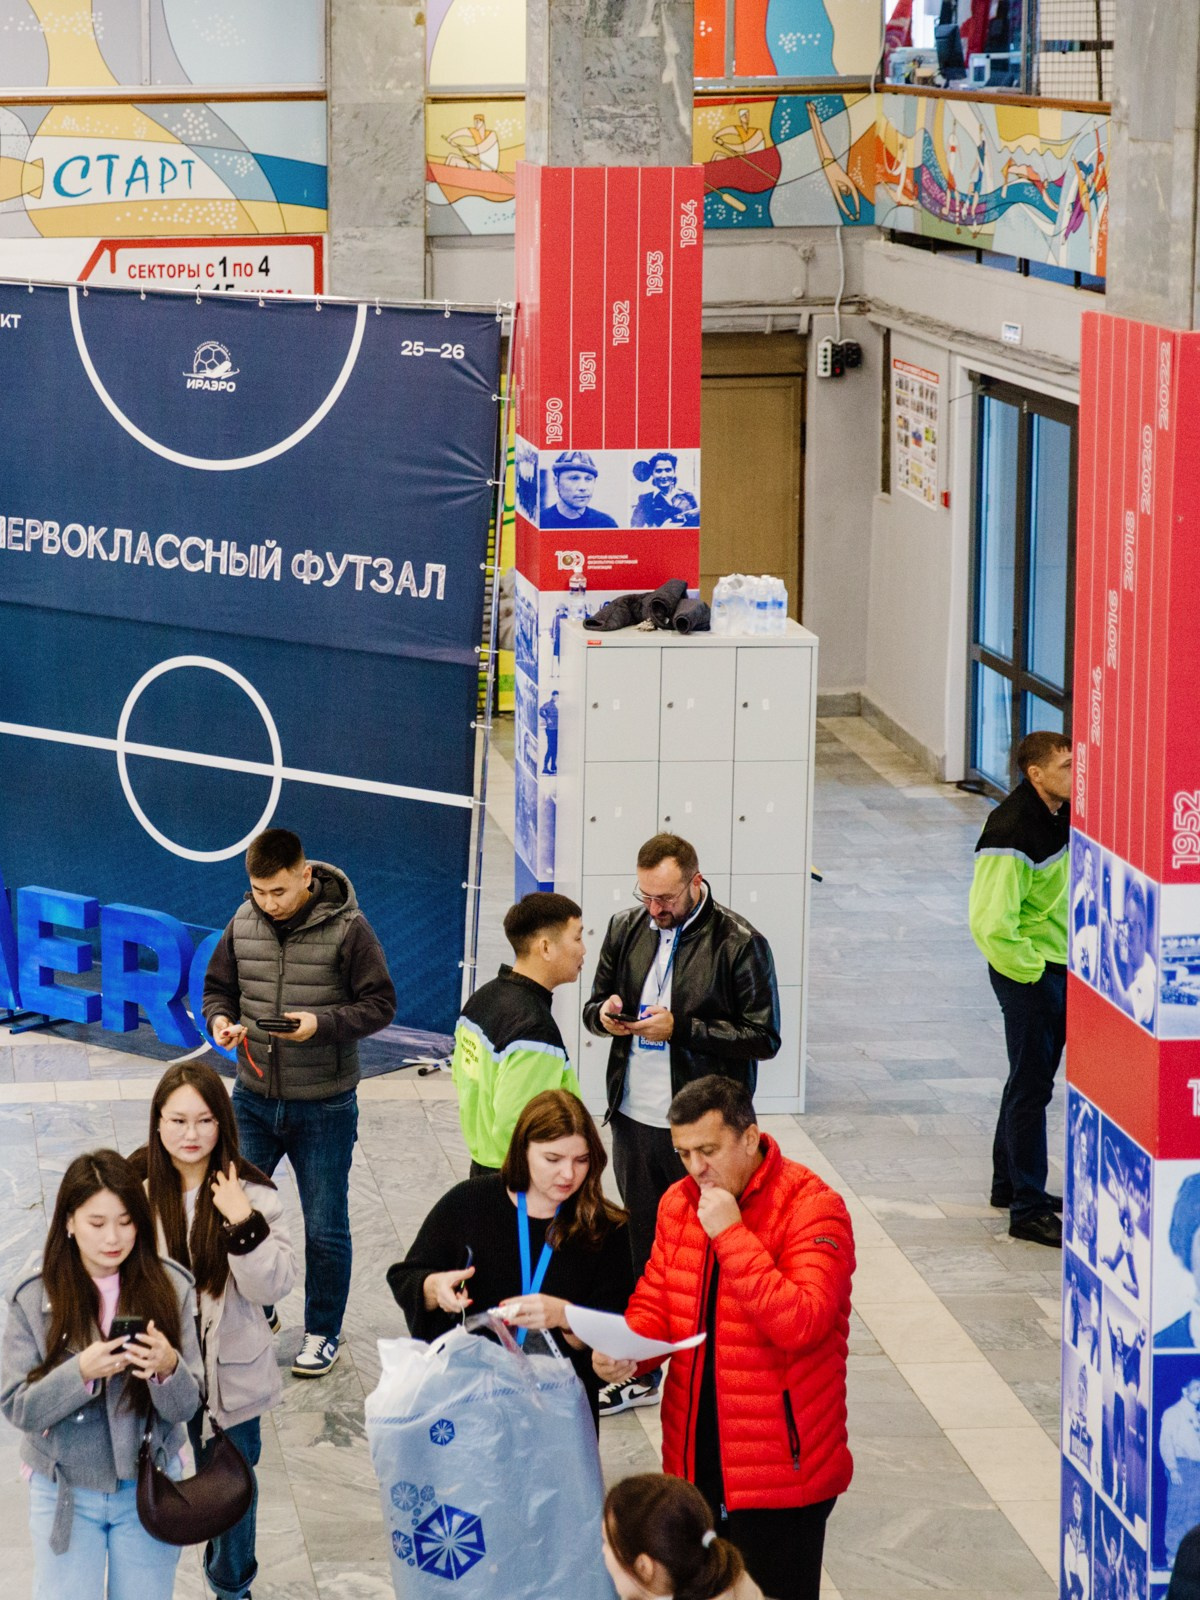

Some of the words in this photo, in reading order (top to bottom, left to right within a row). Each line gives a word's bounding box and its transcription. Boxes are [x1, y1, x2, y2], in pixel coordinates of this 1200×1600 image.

[53, 154, 195, 198] СТАРТ
[680, 199, 698, 248] 1934
[127, 263, 200, 279] СЕКТОРЫ
[218, 256, 227, 278] 1
[232, 262, 254, 278] ПО
[258, 255, 271, 277] 4
[646, 250, 664, 297] 1933
[613, 299, 630, 346] 1932
[186, 378, 237, 393] ИРАЭРО
[579, 351, 597, 393] 1931
[1158, 341, 1171, 431] 2022
[546, 397, 563, 445] 1930
[1141, 424, 1153, 516] 2020
[290, 549, 448, 601] ФУТЗАЛ
[1123, 510, 1135, 592] 2018
[1107, 589, 1119, 670] 2016
[1091, 665, 1102, 747] 2014
[1075, 741, 1087, 818] 2012
[1172, 789, 1200, 869] 1952
